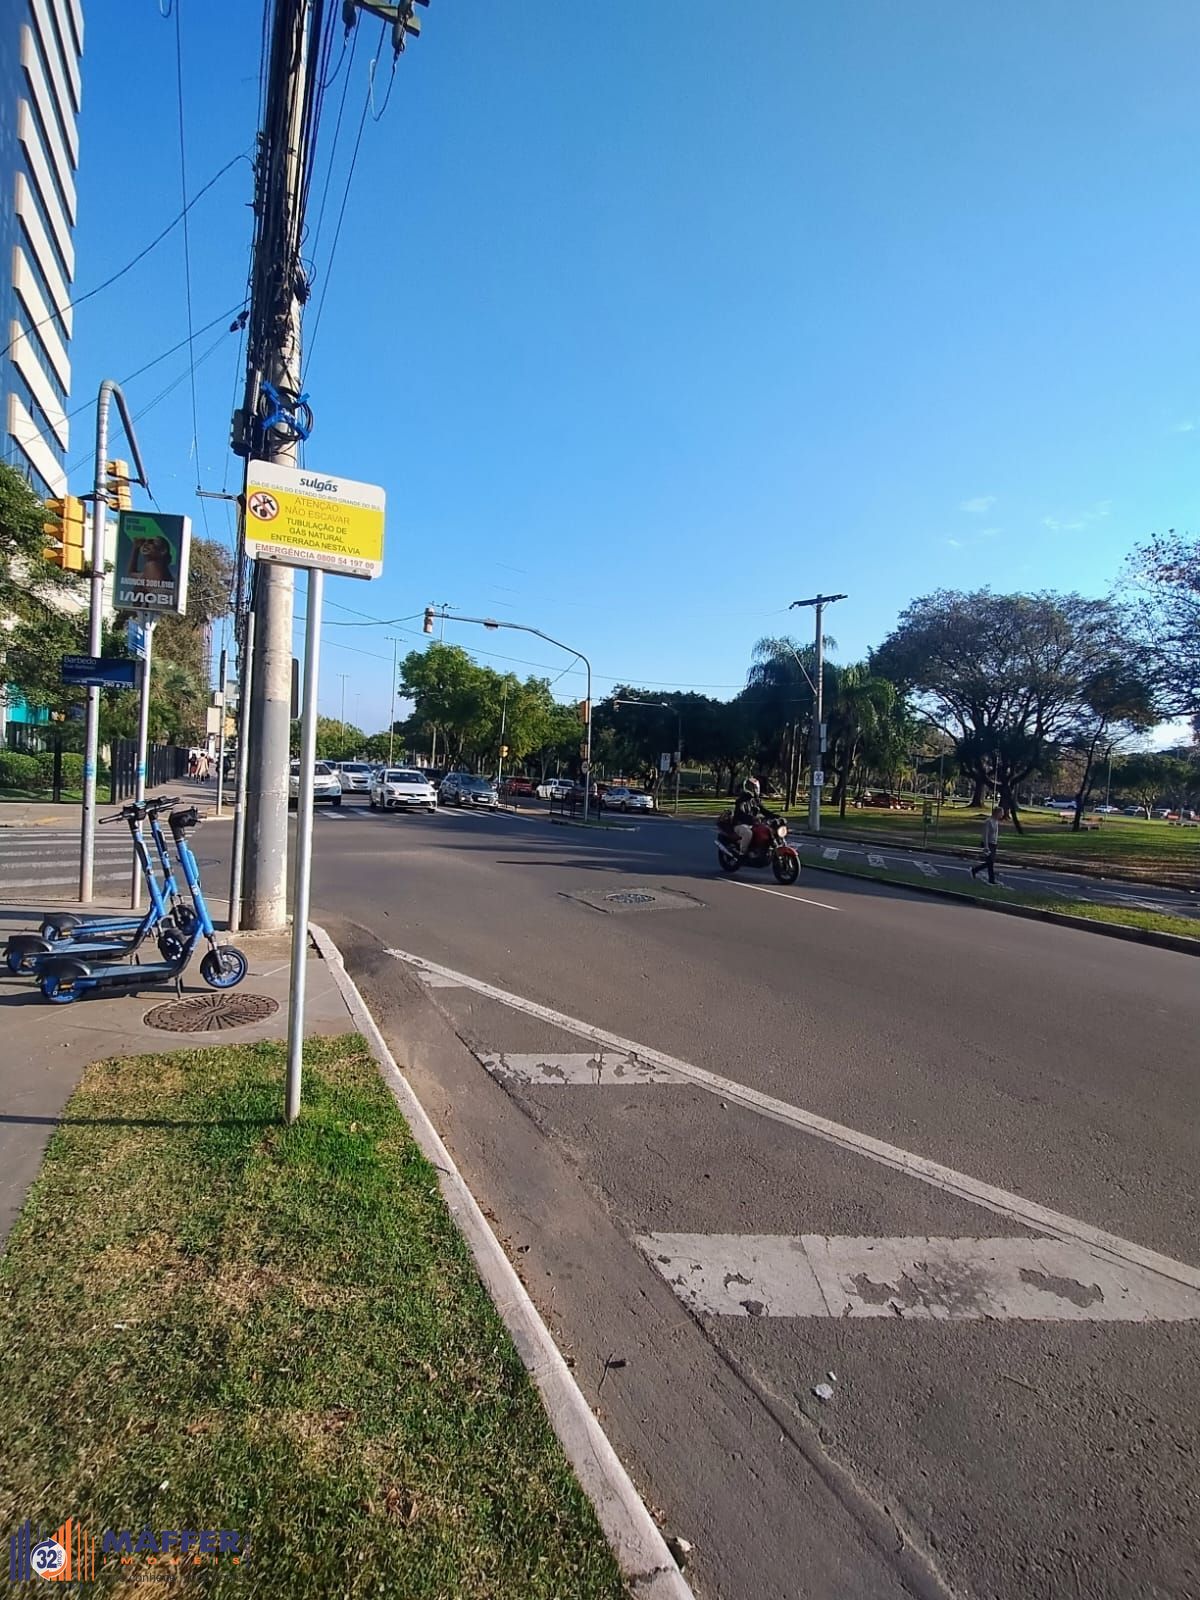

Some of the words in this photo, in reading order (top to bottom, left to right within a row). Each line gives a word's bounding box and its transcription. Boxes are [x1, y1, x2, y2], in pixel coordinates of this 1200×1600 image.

[295, 488, 318, 497] ESTADO
[299, 477, 338, 493] sulgás
[285, 506, 305, 517] NÃO
[308, 511, 350, 525] ESCAVAR
[287, 517, 335, 533] TUBULAÇÃO
[336, 526, 348, 535] DE
[289, 526, 307, 537] GÁS
[308, 531, 344, 543] NATURAL
[271, 533, 320, 548] ENTERRADA
[321, 542, 347, 553] NESTA
[348, 547, 361, 555] VIA
[255, 543, 315, 560] EMERGÊNCIA
[317, 552, 336, 563] 0800
[338, 556, 347, 565] 54
[350, 558, 363, 567] 197
[365, 561, 375, 569] 00
[119, 591, 174, 606] IMOBI
[63, 656, 97, 665] Barbedo
